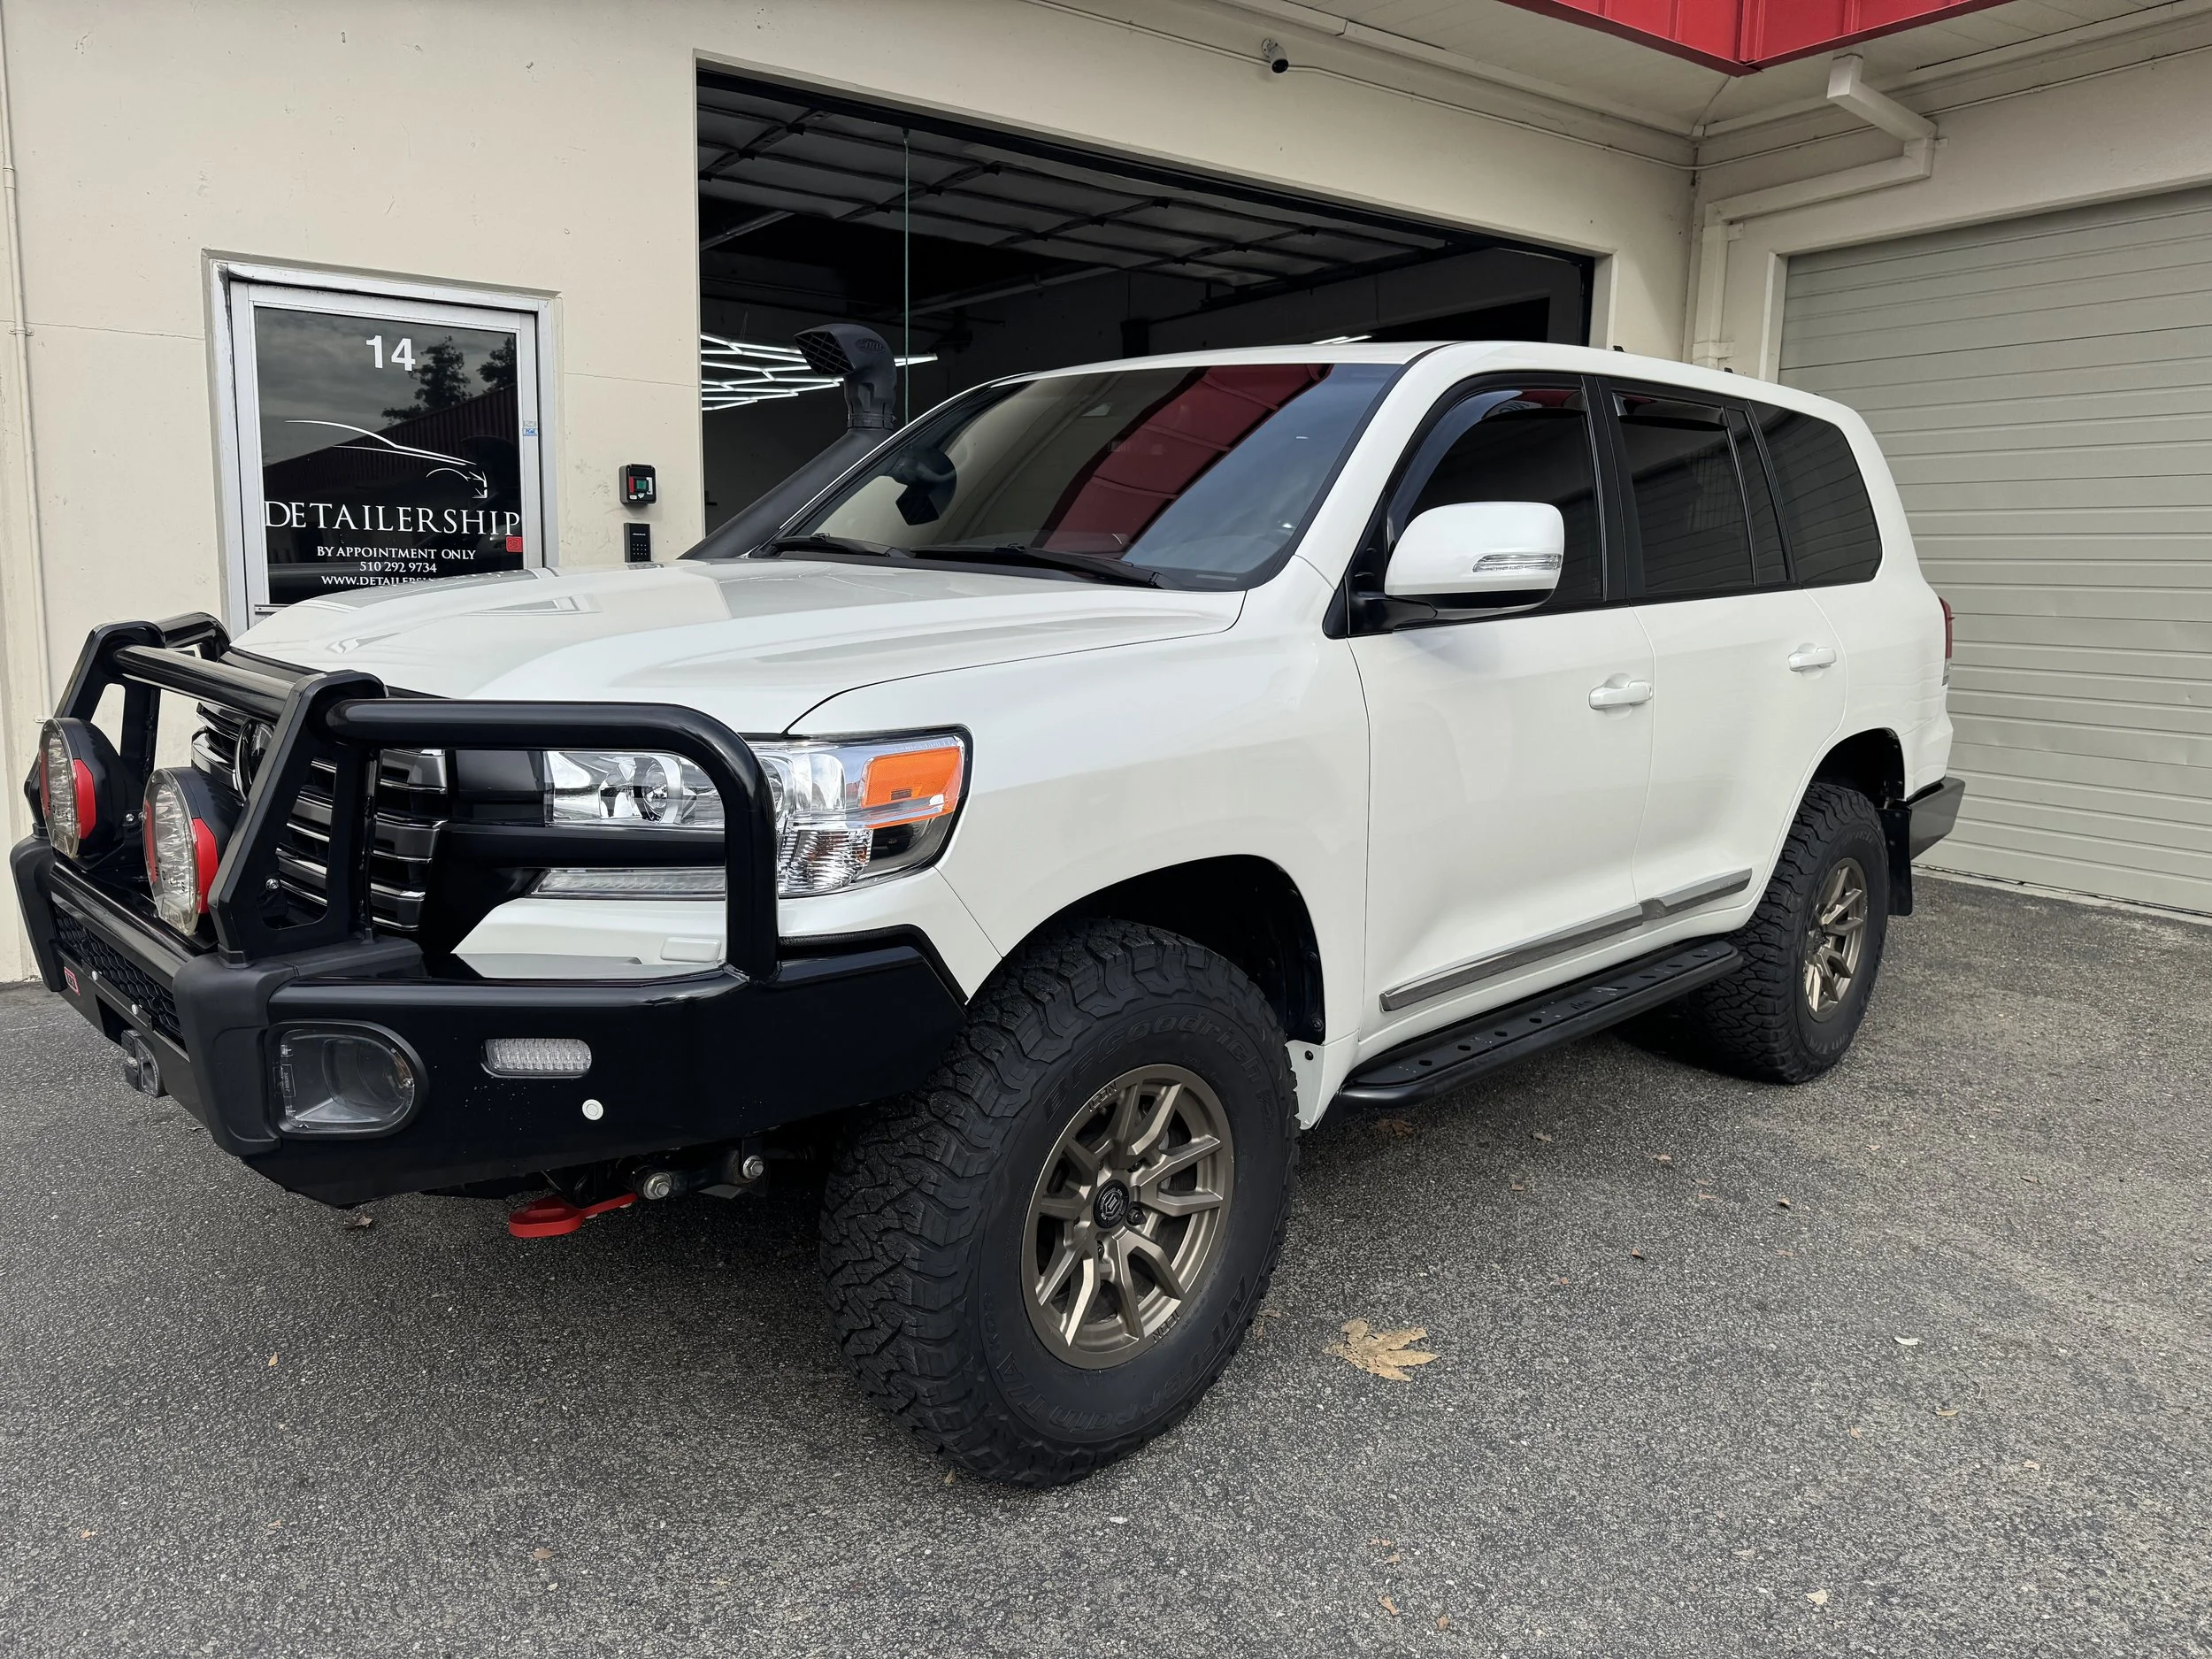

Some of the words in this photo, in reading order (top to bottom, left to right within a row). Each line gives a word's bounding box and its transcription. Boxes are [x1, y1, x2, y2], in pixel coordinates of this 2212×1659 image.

[365, 335, 416, 372] 14
[264, 500, 520, 536] DETAILERSHIP
[317, 546, 335, 557] BY
[336, 547, 437, 559] APPOINTMENT
[442, 549, 477, 560] ONLY
[359, 561, 381, 572] 510
[383, 561, 406, 572] 292
[408, 562, 437, 573] 9734
